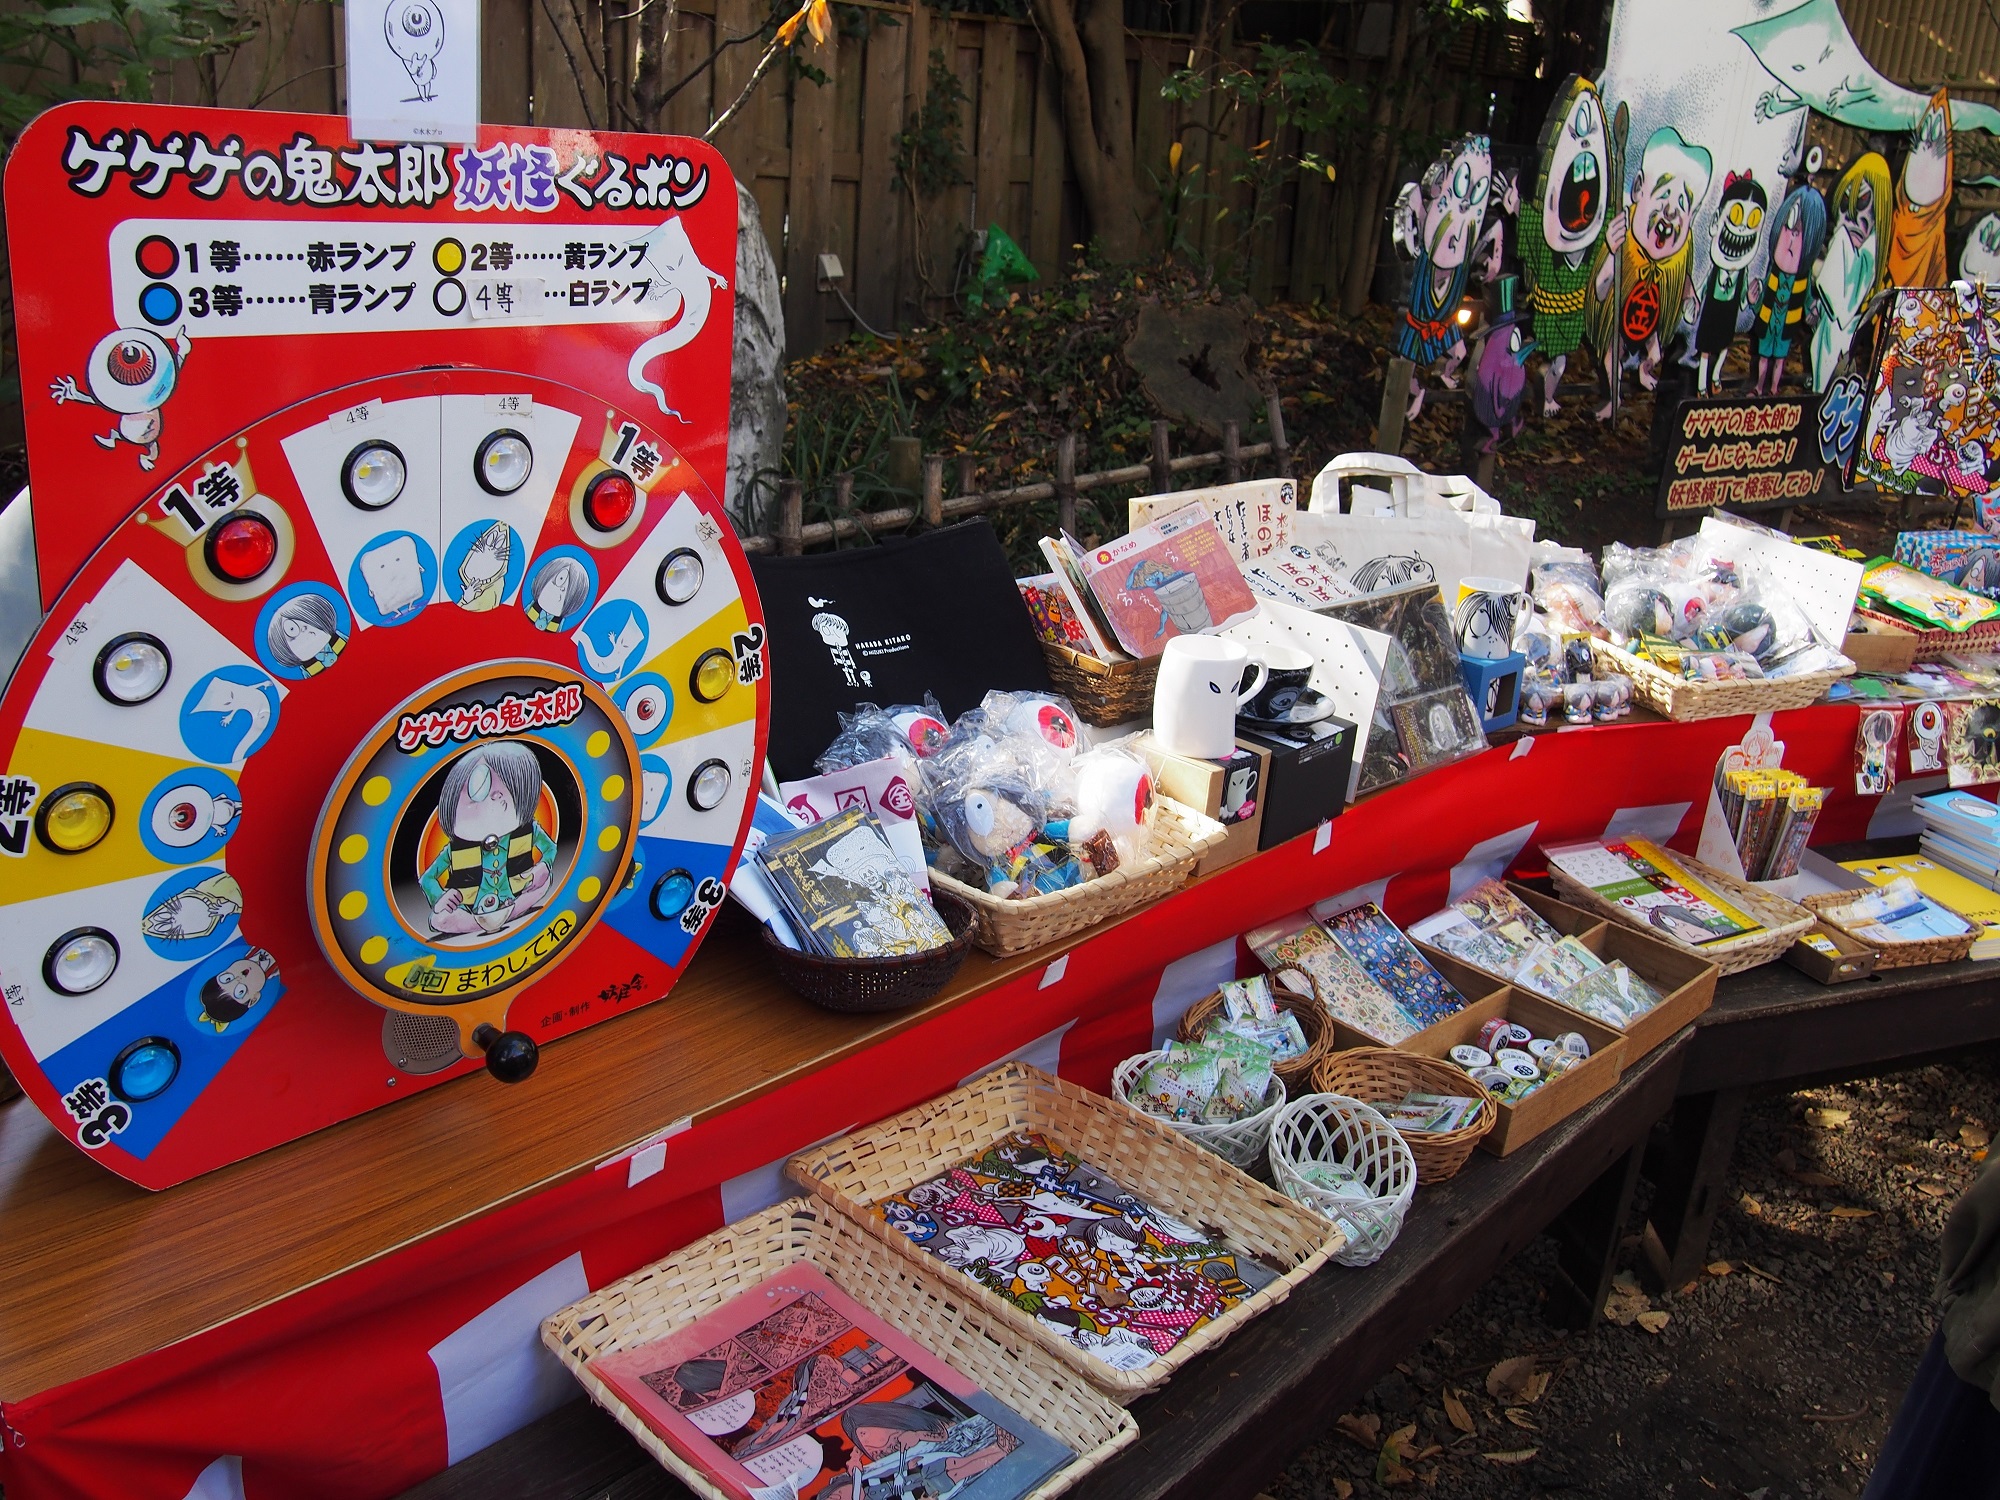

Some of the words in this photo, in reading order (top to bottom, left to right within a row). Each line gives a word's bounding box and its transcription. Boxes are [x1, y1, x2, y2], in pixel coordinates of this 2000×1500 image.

[346, 405, 370, 423] 4等
[498, 396, 520, 410] 4等
[1683, 404, 1801, 438] ゲゲゲの鬼太郎が
[612, 424, 659, 481] 1等
[163, 467, 240, 532] 1等
[65, 618, 88, 646] 4等
[733, 626, 763, 682] 2等
[884, 633, 911, 646] KITARO
[401, 687, 580, 746] ゲゲゲの鬼太郎
[683, 879, 724, 932] 3等
[456, 917, 573, 992] まわしてね
[541, 1001, 590, 1028] 企画・制作
[66, 1081, 129, 1146] 3等
